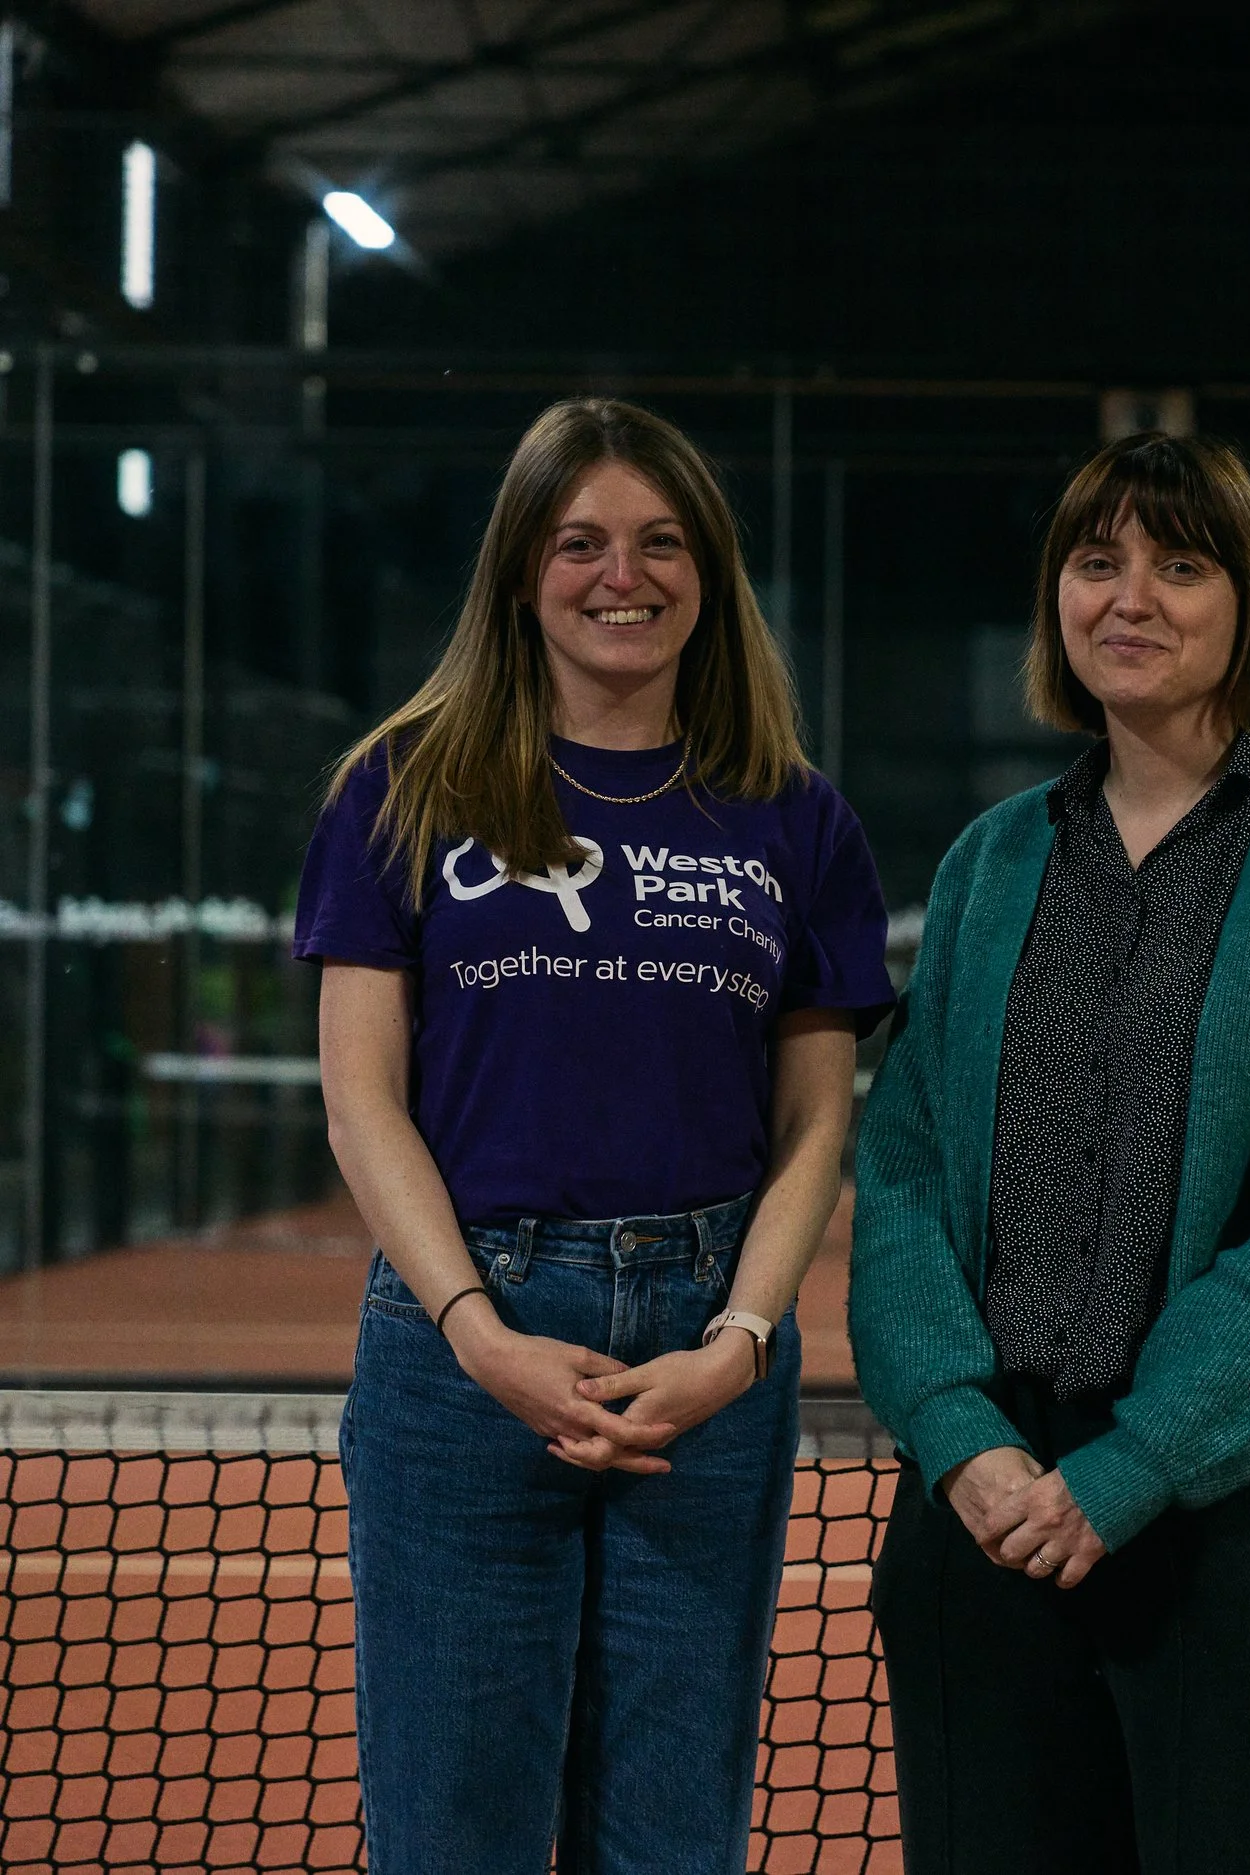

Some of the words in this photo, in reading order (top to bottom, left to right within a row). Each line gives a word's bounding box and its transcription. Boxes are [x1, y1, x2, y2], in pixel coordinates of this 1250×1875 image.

[620, 844, 784, 903] Weston
[633, 875, 747, 911] Park
[634, 908, 722, 930] Cancer
[728, 917, 782, 965] Charity
[450, 946, 588, 990] Together
[595, 955, 627, 980] at
[637, 959, 730, 993] every
